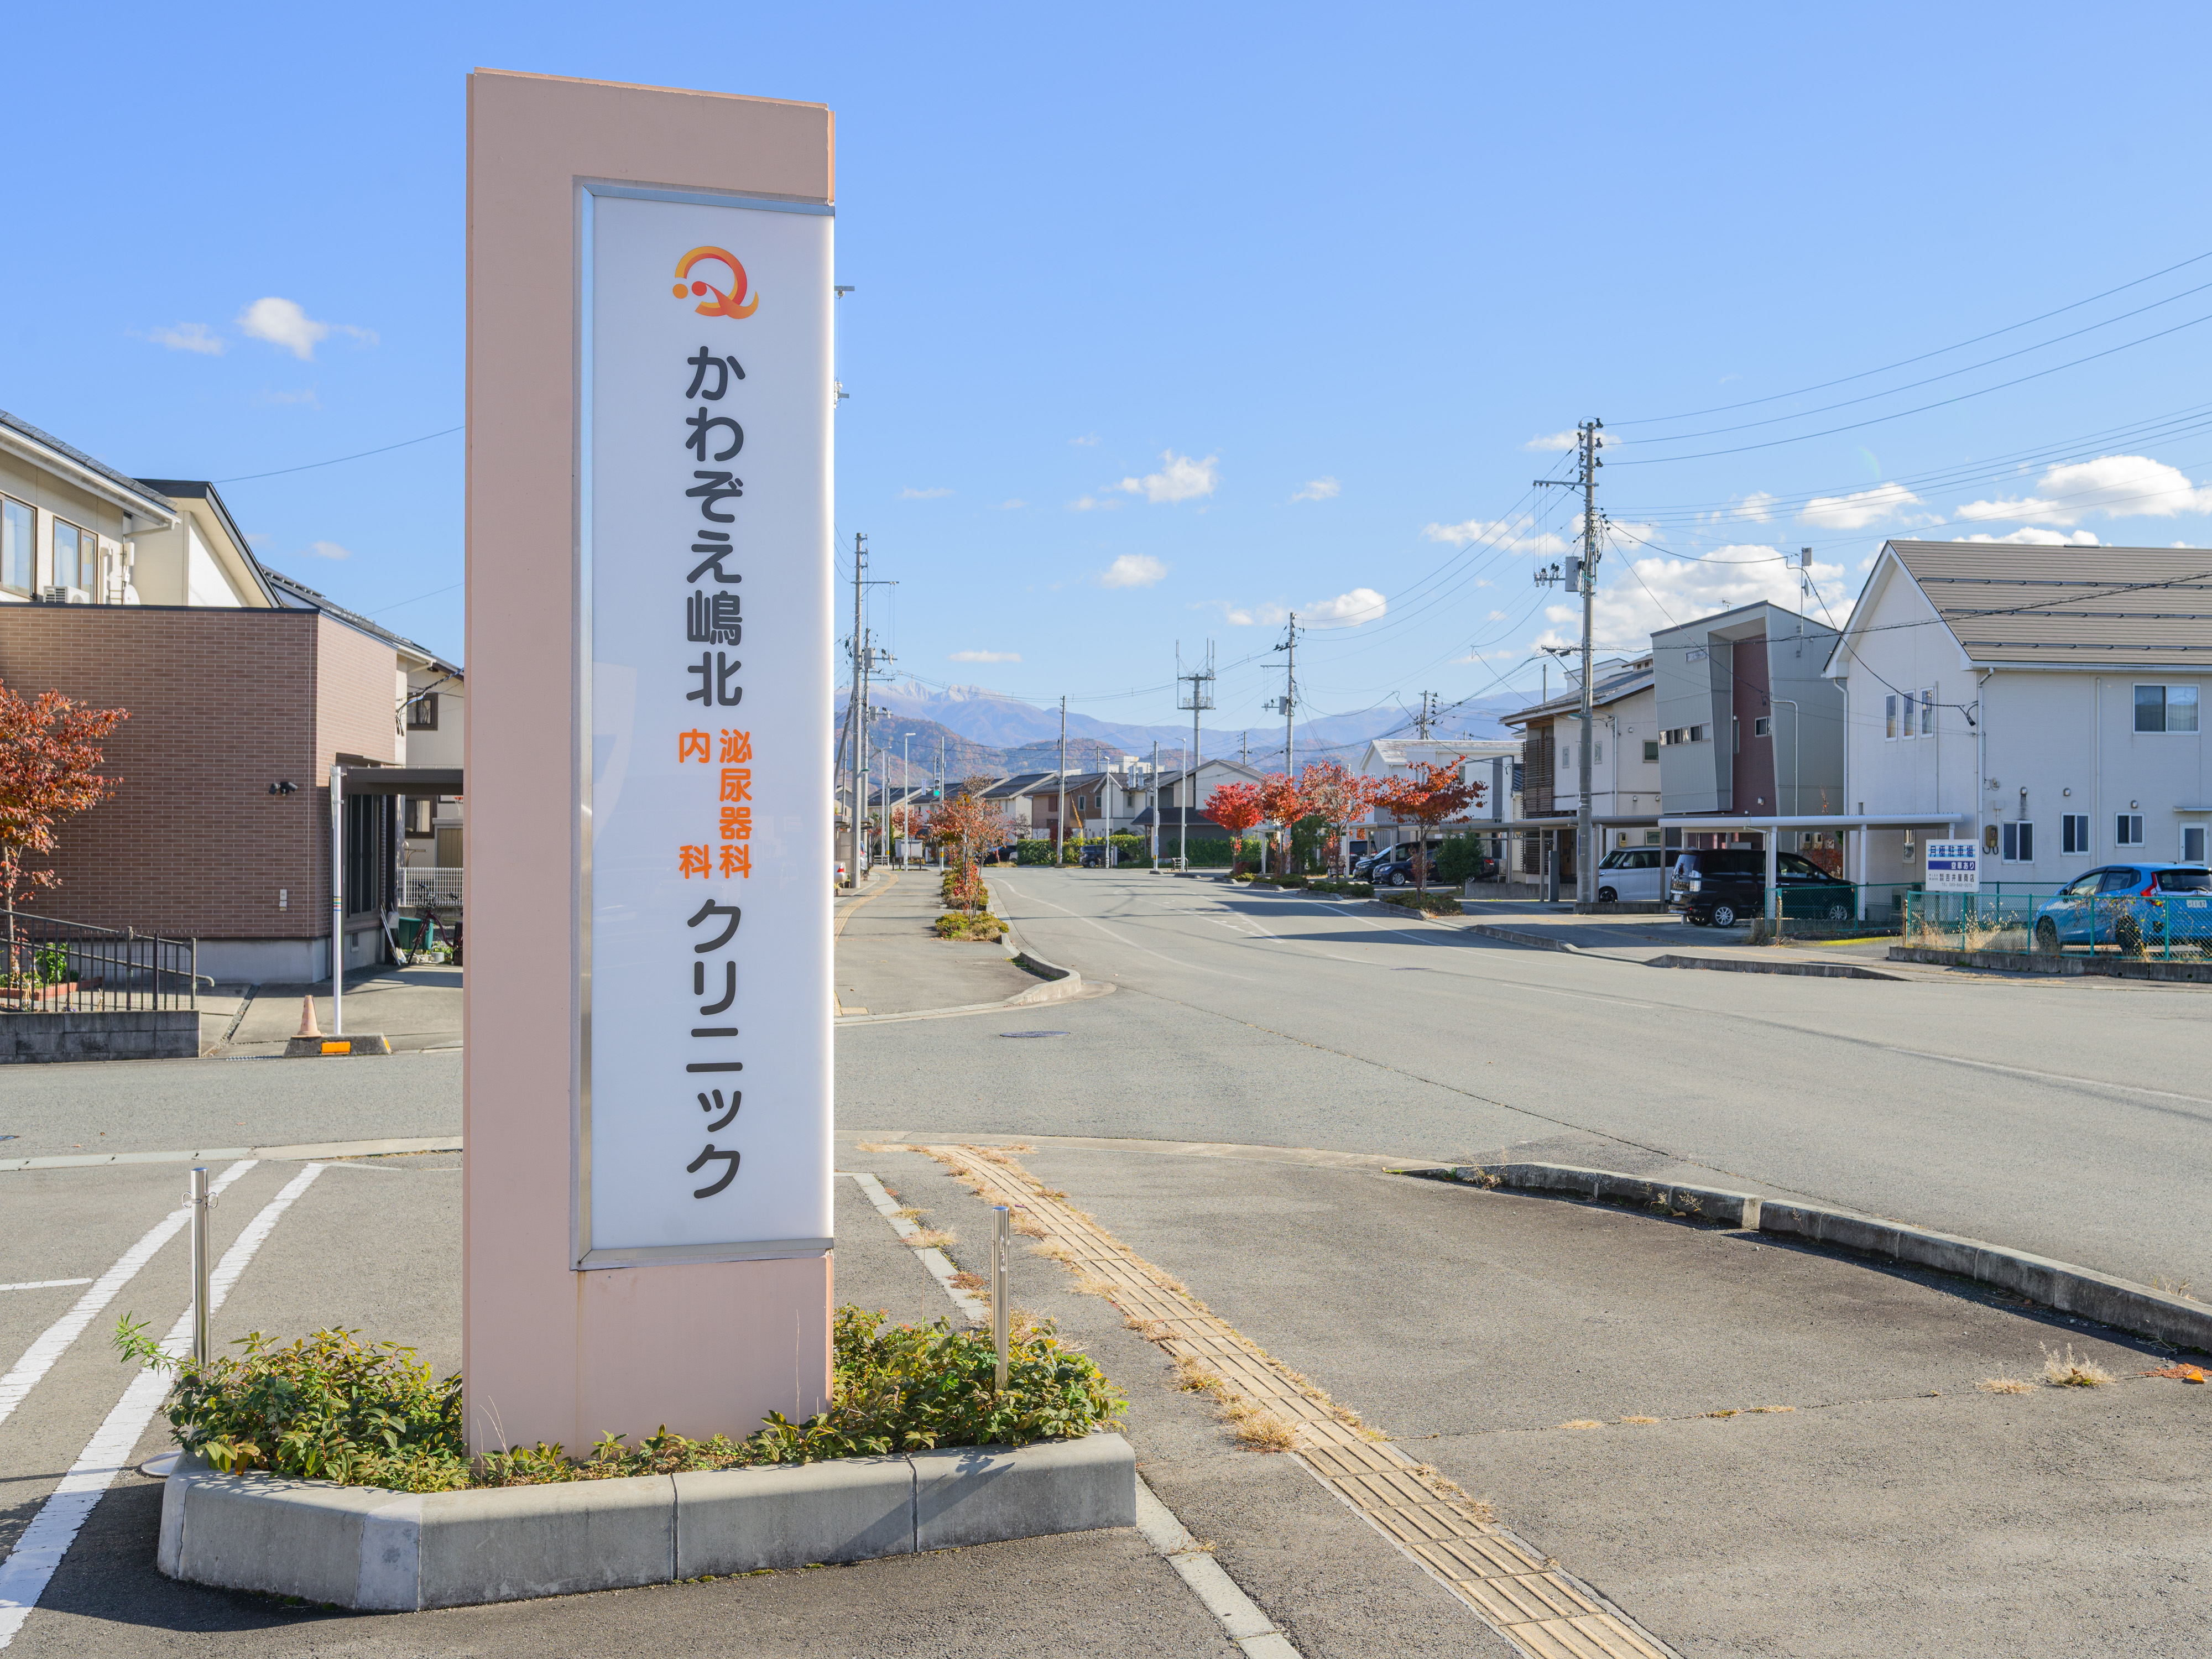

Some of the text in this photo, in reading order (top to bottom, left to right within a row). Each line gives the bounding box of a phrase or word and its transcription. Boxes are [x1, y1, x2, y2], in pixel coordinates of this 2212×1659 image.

[685, 346, 745, 706] かわぞえ嶋北
[679, 728, 712, 879] 内科
[719, 728, 752, 878] 泌尿器科
[1930, 845, 1973, 857] 月極駐車場
[1951, 862, 1974, 870] 空車あり
[686, 899, 743, 1198] クリニック
